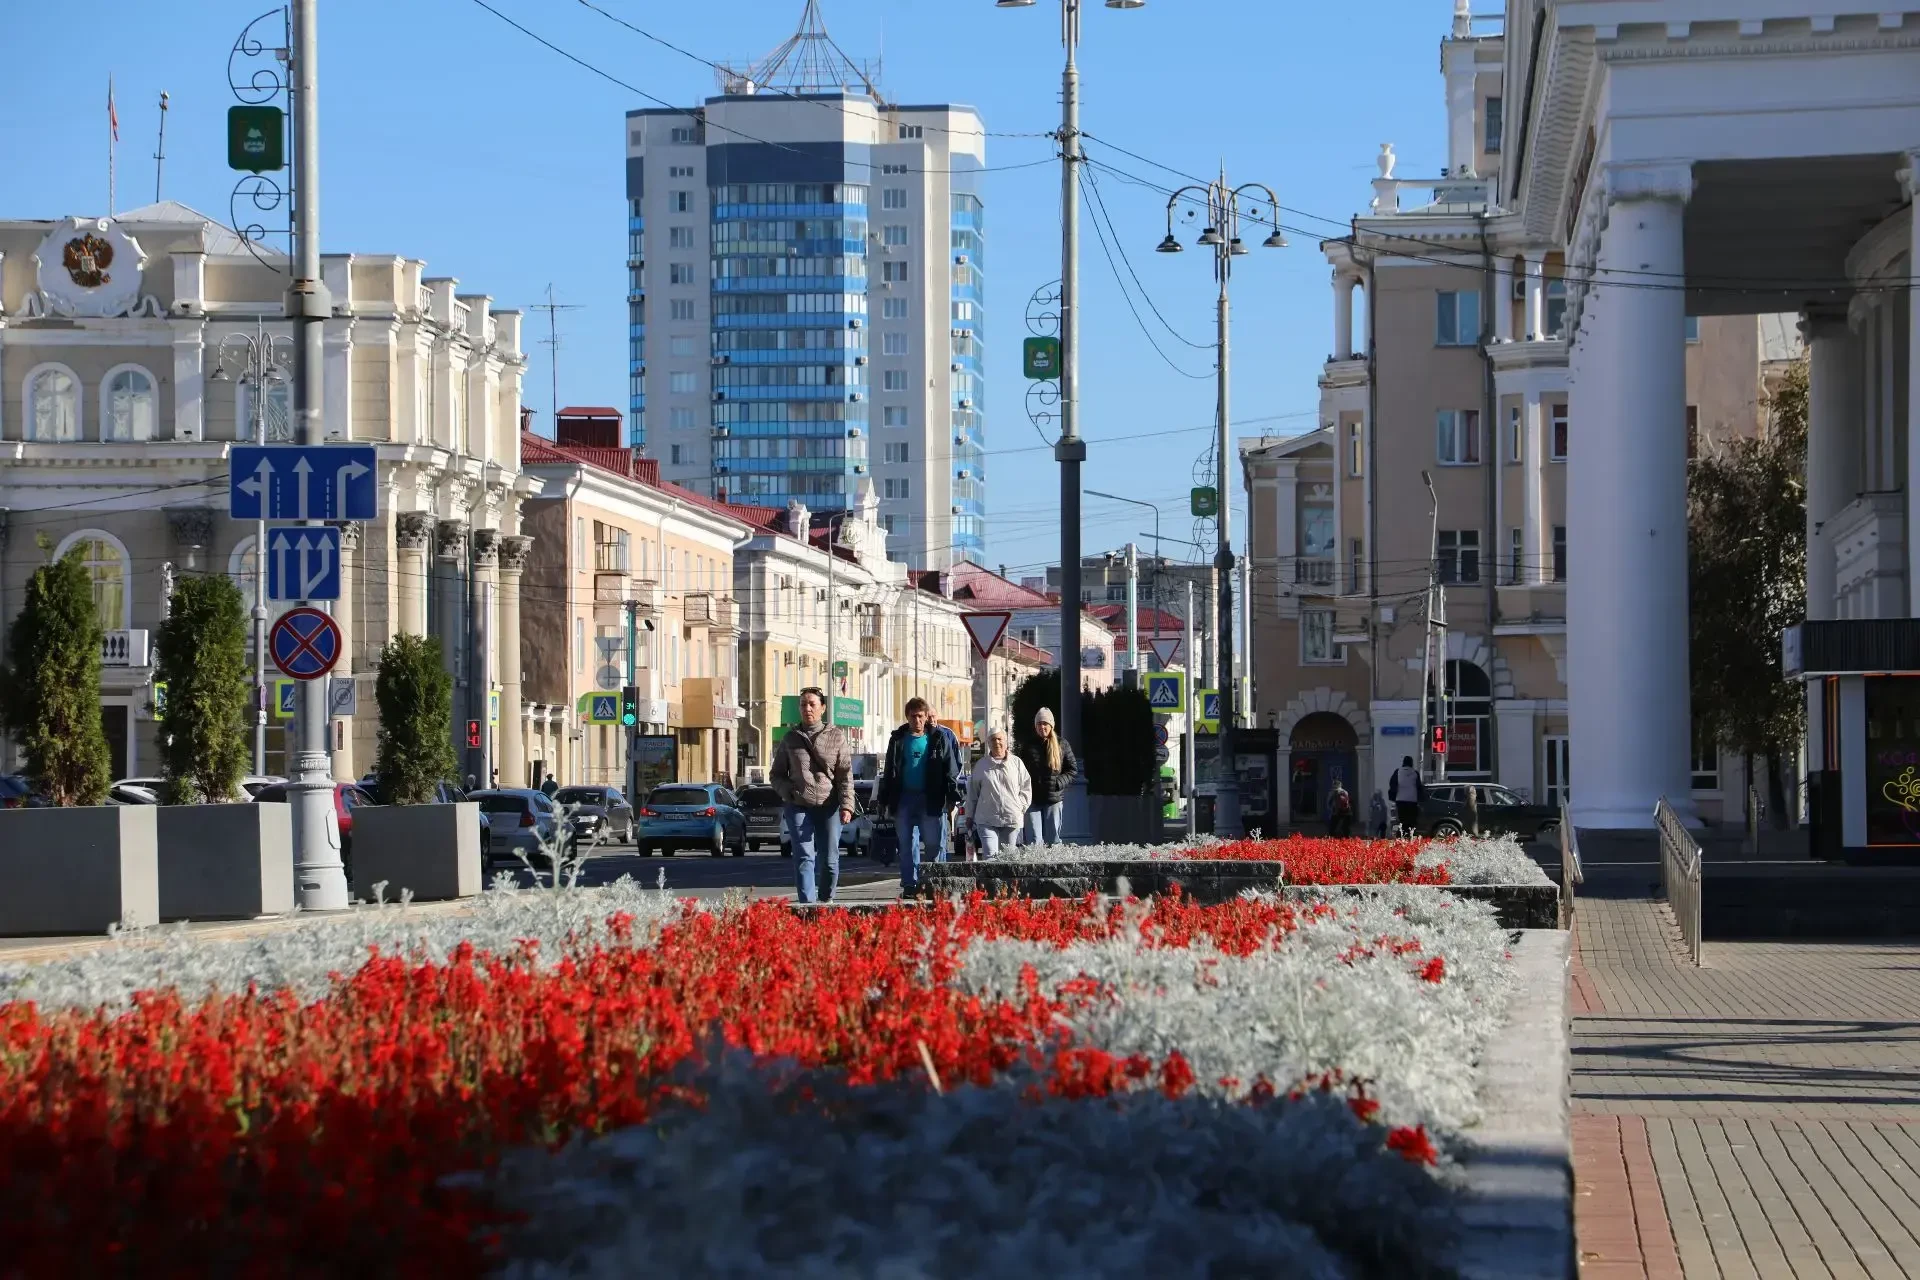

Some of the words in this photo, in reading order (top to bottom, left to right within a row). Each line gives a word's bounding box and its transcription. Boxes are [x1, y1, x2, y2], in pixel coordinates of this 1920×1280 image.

[626, 702, 635, 710] 34
[467, 735, 481, 747] 40
[1432, 741, 1446, 753] 40
